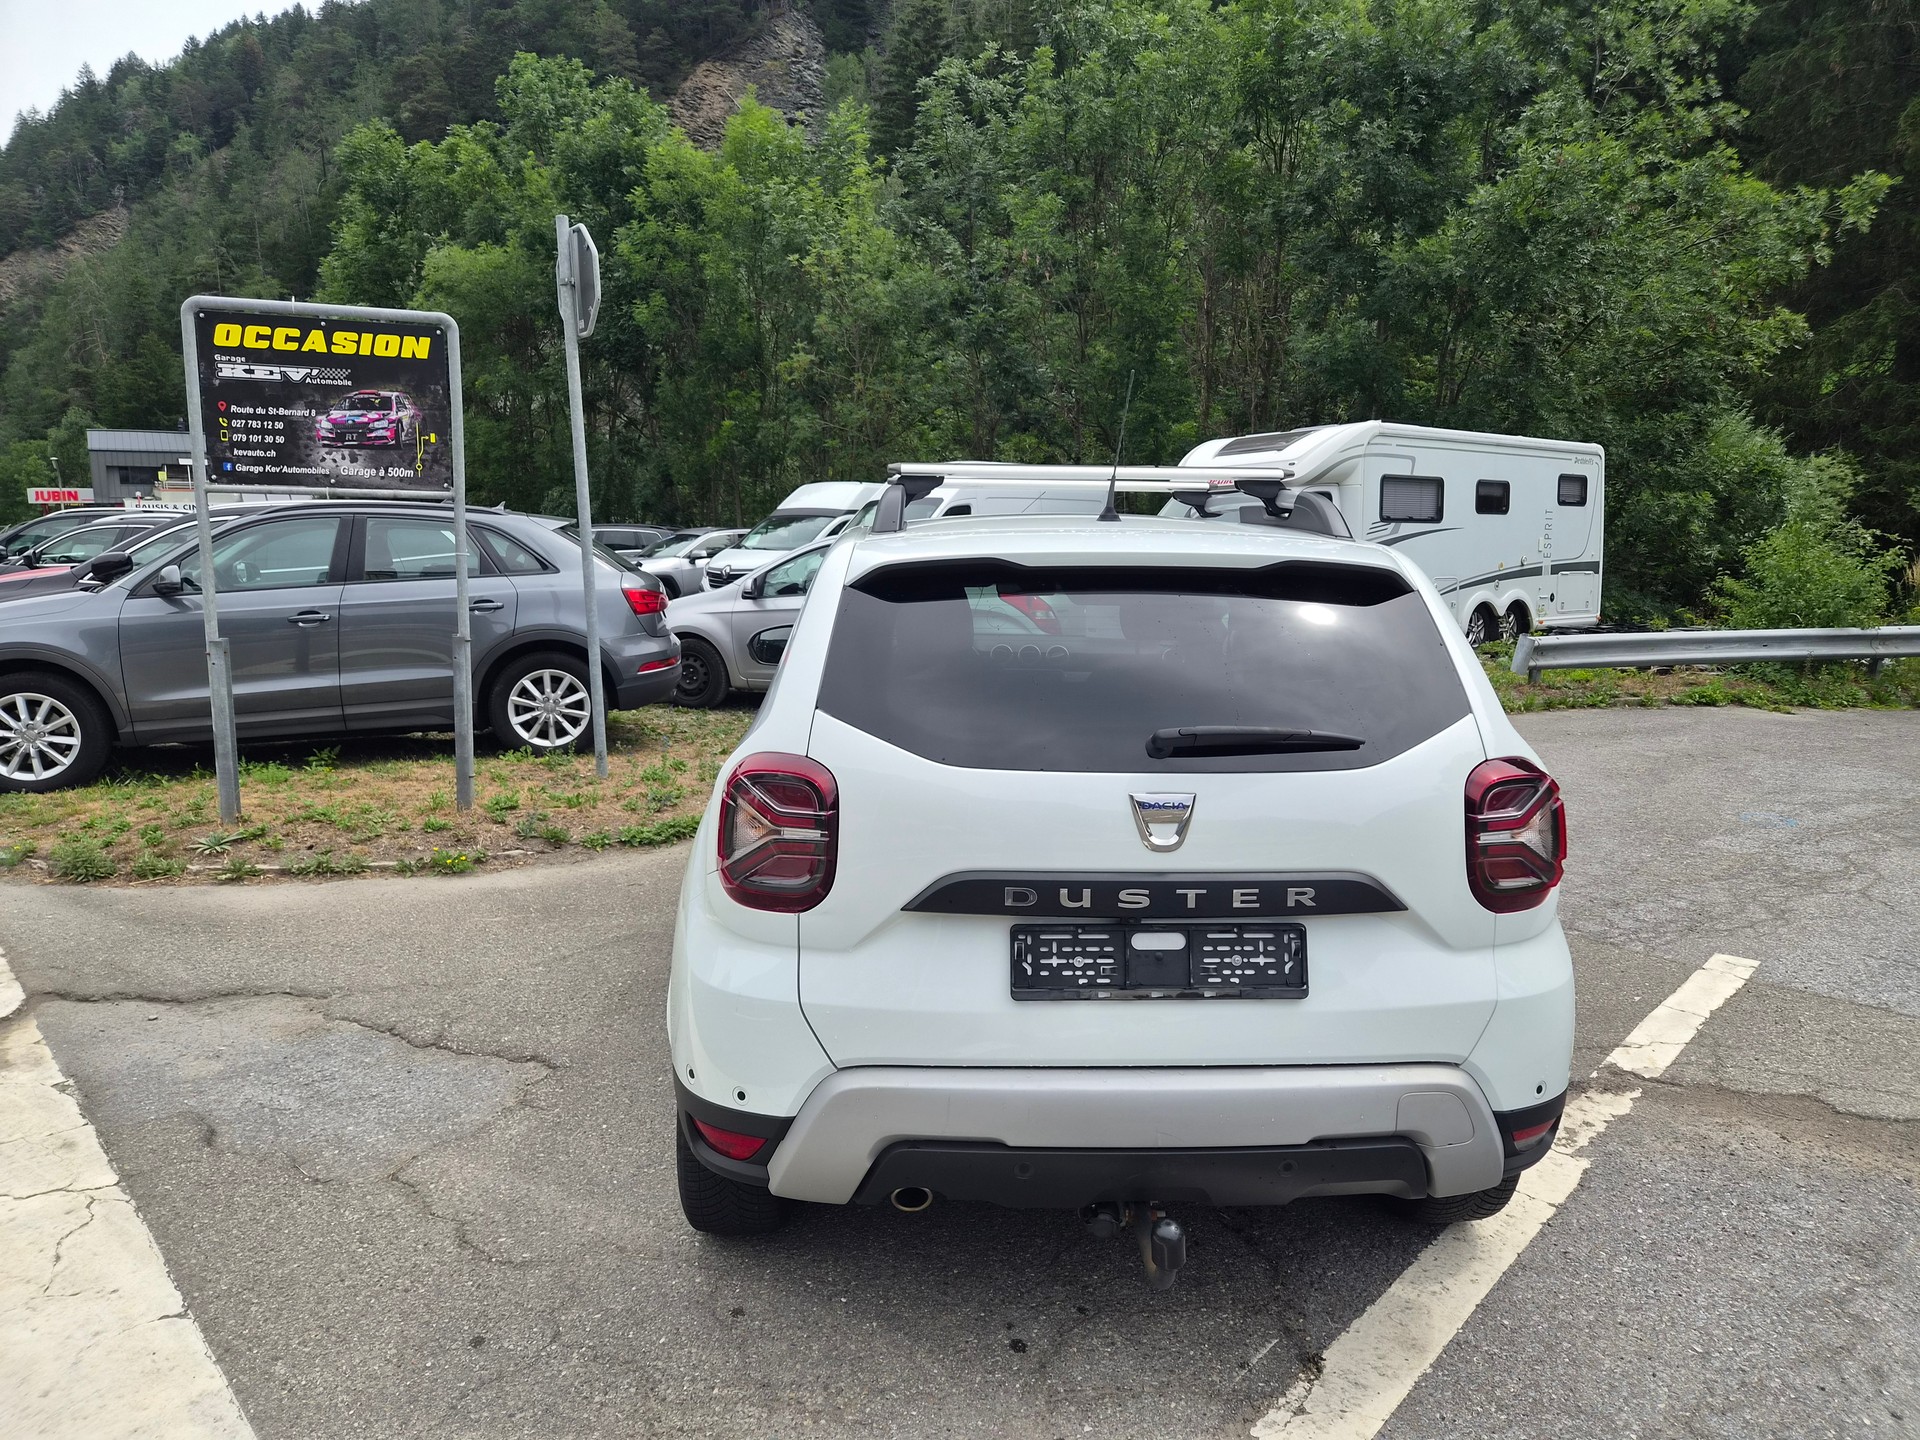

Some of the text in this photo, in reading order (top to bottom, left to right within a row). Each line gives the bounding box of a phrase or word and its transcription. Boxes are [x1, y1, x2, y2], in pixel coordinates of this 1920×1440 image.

[213, 323, 431, 360] OCCASION
[214, 354, 246, 363] Garage
[305, 377, 352, 387] Automobile
[230, 404, 316, 417] Route du St-Bernard 8
[231, 419, 284, 430] 027 783 12 50
[232, 433, 285, 444] 079 101 30 50
[233, 447, 276, 458] kevauto.ch
[235, 463, 330, 475] Garage Kev'Automobiles
[340, 465, 414, 478] Garage à 500m
[34, 490, 79, 502] JUBIN
[1542, 509, 1553, 559] ESPRIT
[1141, 801, 1186, 810] DACIA
[1004, 886, 1317, 909] DUSTER
